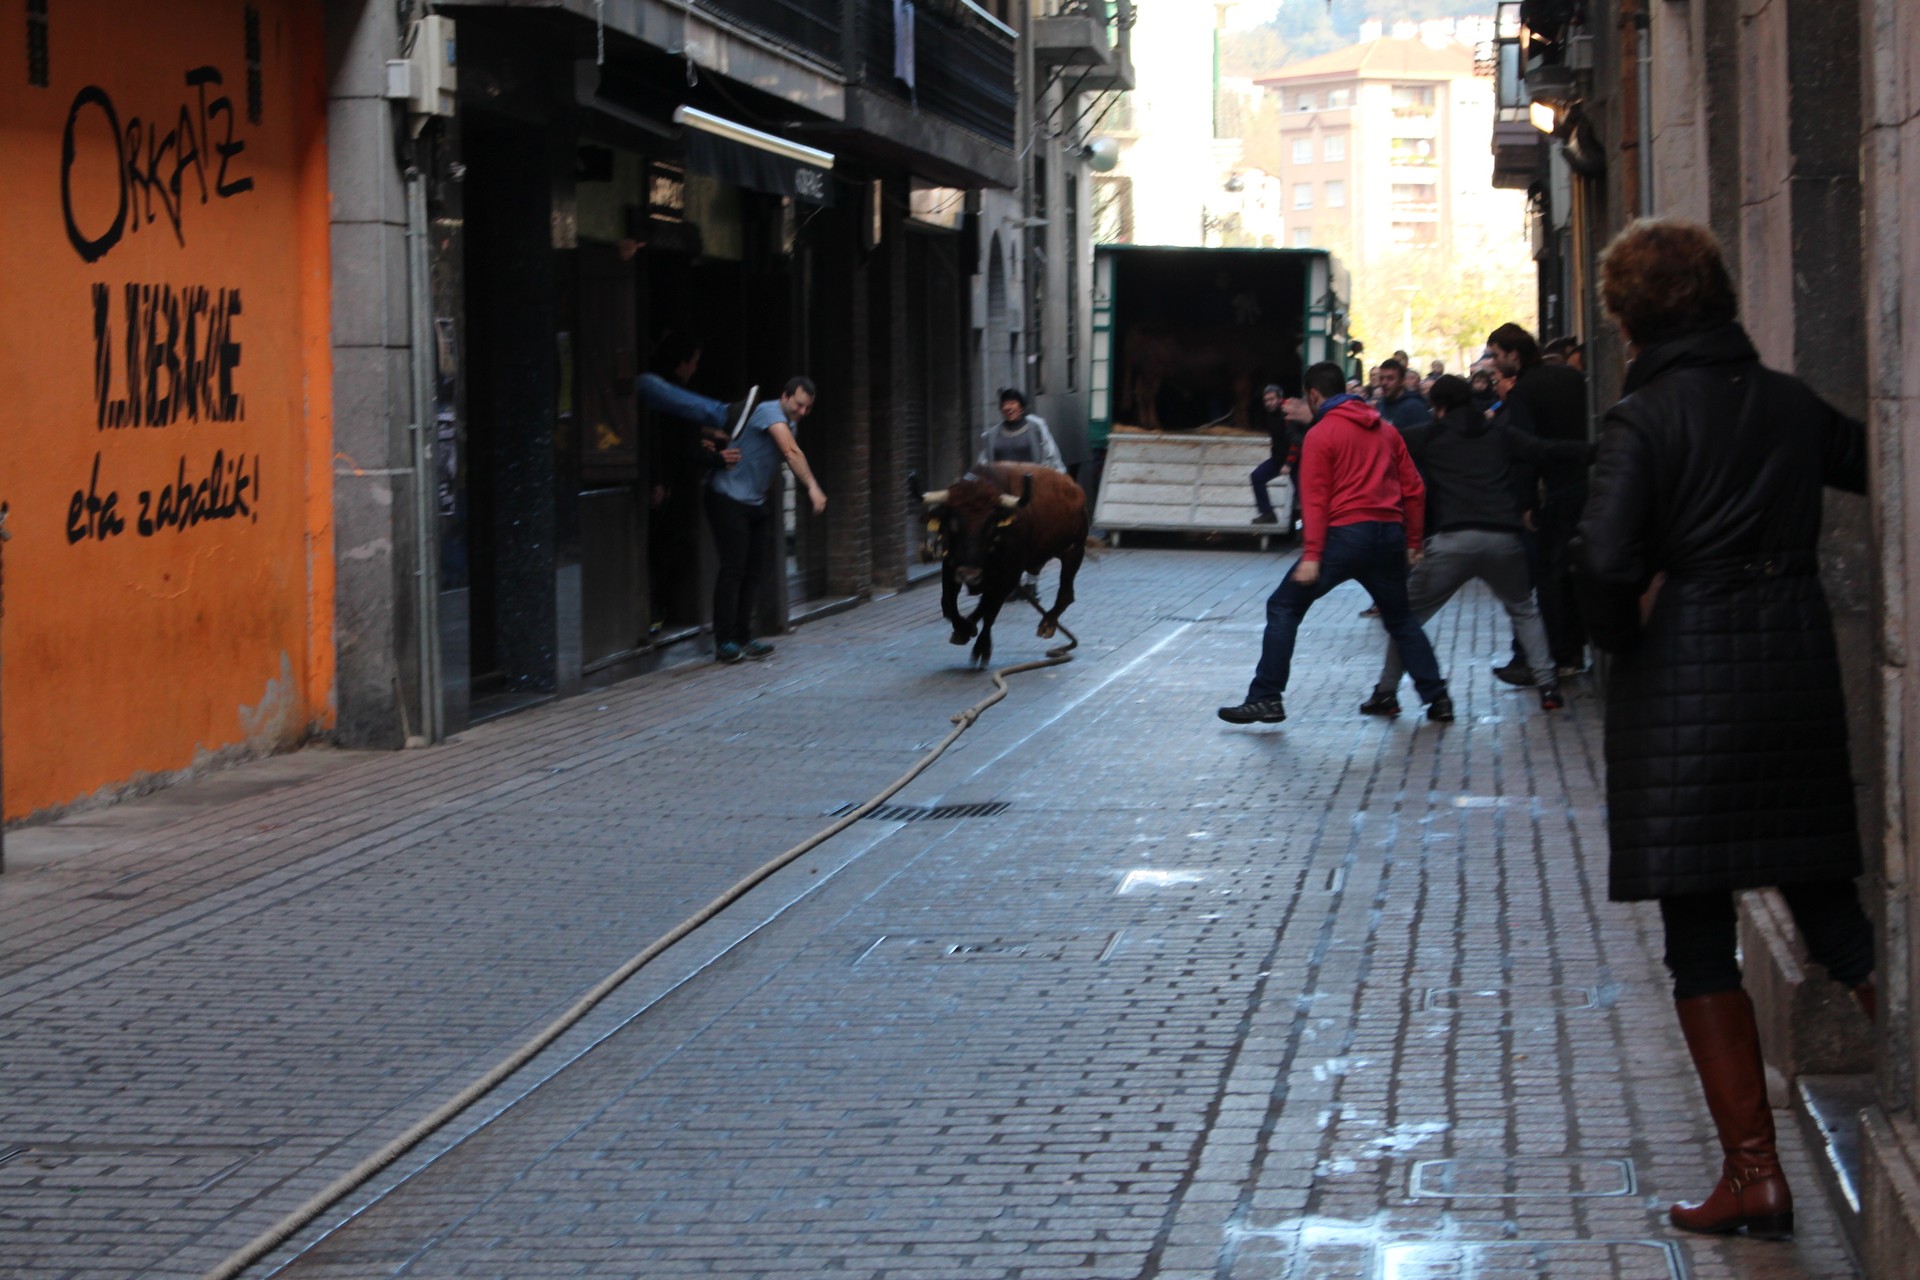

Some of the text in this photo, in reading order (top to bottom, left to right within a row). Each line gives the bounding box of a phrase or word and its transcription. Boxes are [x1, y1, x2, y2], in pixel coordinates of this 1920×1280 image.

[92, 282, 244, 431] LIBRE
[66, 449, 259, 545] eta zabalik!
